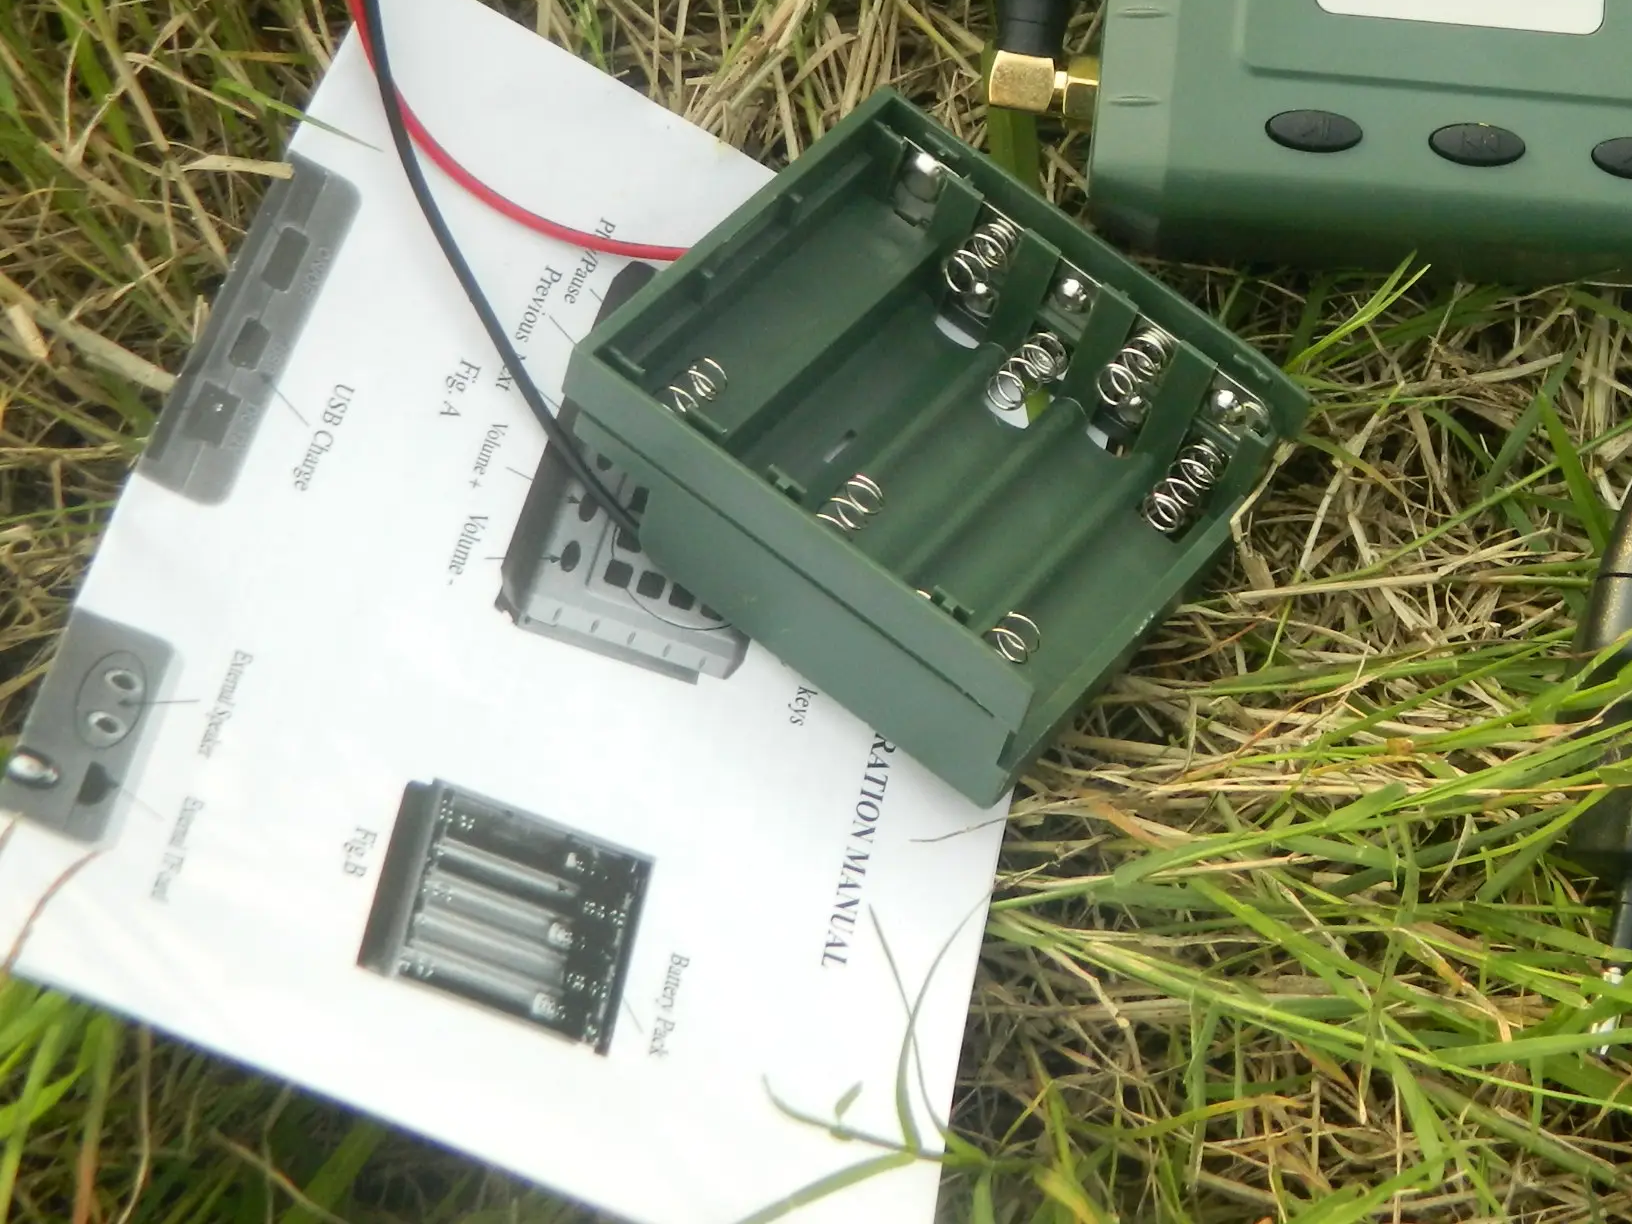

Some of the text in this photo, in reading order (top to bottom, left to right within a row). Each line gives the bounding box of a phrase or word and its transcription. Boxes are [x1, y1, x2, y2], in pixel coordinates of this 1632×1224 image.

[563, 216, 616, 305] Pl/Pause
[515, 263, 563, 344] Previous
[438, 358, 482, 419] Fig. A
[293, 382, 355, 492] USB Charge
[472, 422, 509, 476] Volume
[448, 512, 489, 576] Volume
[197, 649, 254, 760] External Speaker
[787, 684, 819, 727] keys
[820, 844, 871, 969] MANUAL
[648, 950, 691, 1061] Battery Pack
